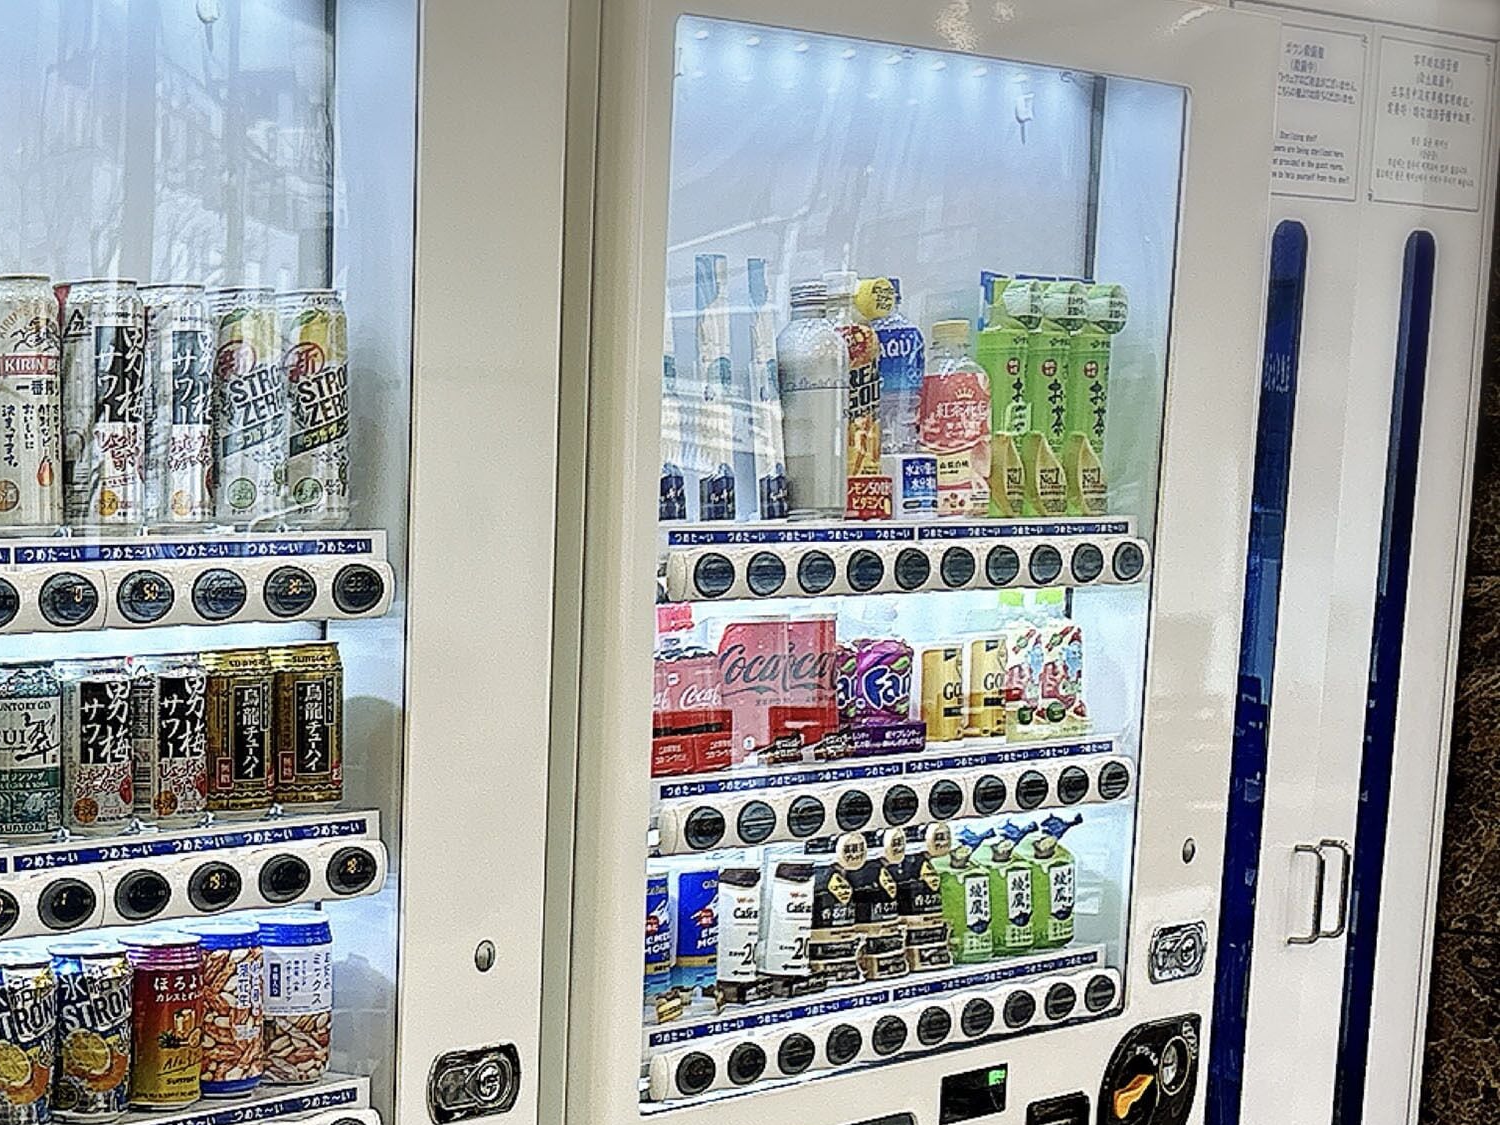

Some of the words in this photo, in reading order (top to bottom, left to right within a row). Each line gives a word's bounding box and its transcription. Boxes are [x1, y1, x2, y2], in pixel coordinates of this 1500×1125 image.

[5, 360, 44, 373] KIRIN
[95, 345, 123, 424] サワー
[172, 349, 198, 425] サワー
[297, 364, 349, 403] STRO
[80, 698, 104, 764] サワー
[99, 681, 132, 763] 男梅
[160, 693, 185, 758] サワー
[177, 676, 207, 757] 男梅
